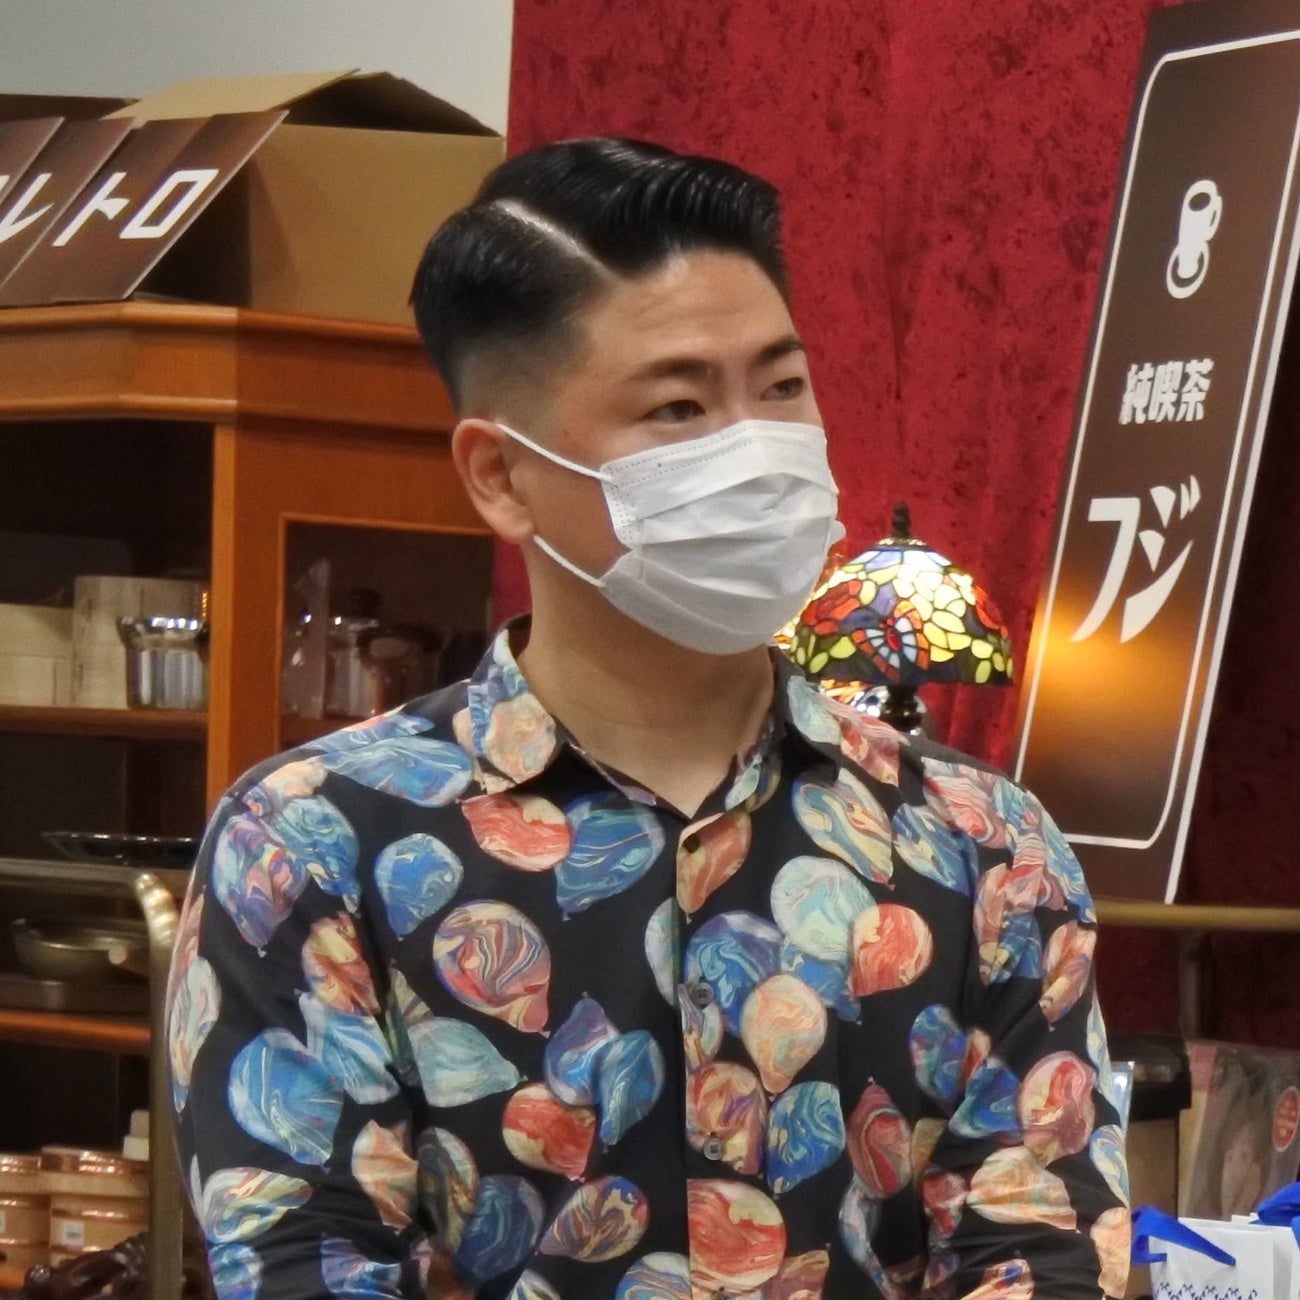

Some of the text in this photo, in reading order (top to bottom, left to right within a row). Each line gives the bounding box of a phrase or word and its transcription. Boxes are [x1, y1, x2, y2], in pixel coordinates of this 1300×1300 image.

[1118, 357, 1215, 425] 純喫茶
[1069, 474, 1202, 644] フジ
